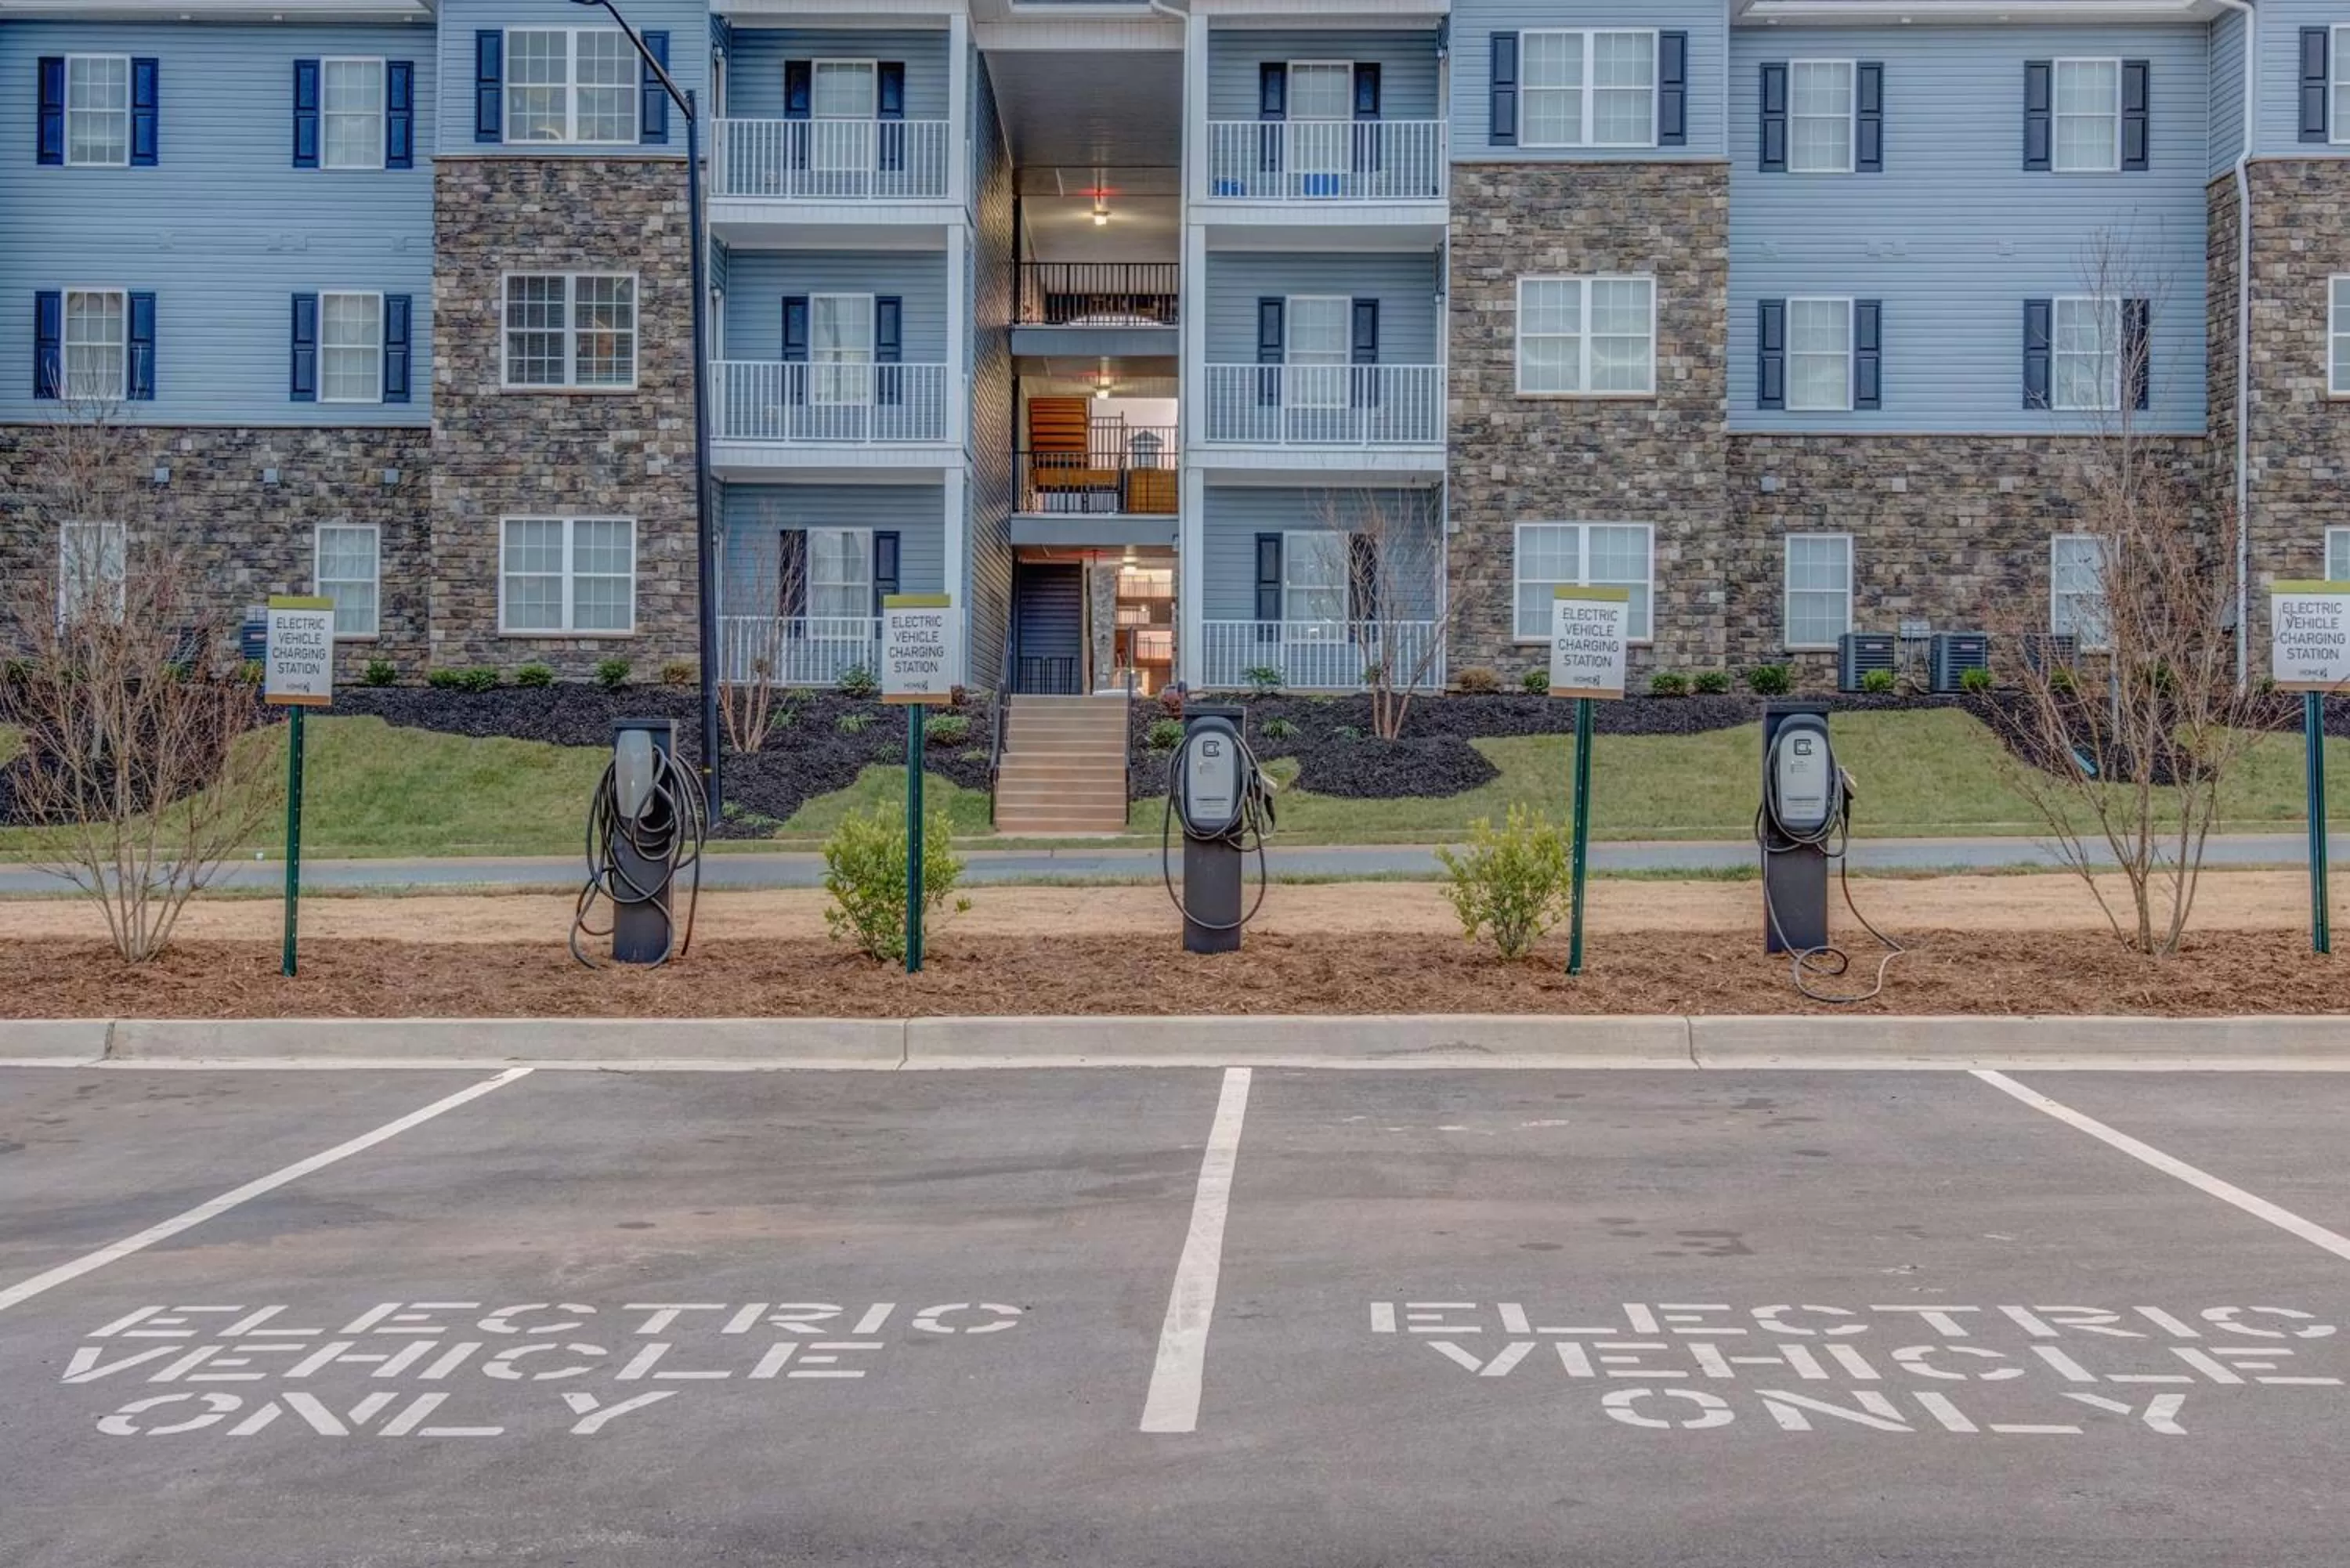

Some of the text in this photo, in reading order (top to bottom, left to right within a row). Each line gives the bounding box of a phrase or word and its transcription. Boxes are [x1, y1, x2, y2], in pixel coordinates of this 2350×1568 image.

[2282, 602, 2343, 614] ELECTRIC
[1562, 608, 1618, 622] ELECTRIC
[276, 616, 325, 630] ELECTRIC
[891, 616, 942, 628] ELECTRIC
[2286, 616, 2340, 629] VEHICLE
[894, 630, 939, 643] VEHICLE
[1564, 623, 1614, 637] VEHICLE
[278, 632, 321, 645] VEHICLE
[1558, 638, 1619, 652] CHARGING
[2280, 632, 2346, 645] CHARGING
[272, 647, 326, 660] CHARGING
[889, 645, 944, 658] CHARGING
[2287, 648, 2340, 659] STATION
[893, 660, 938, 673] STATION
[1563, 654, 1612, 667] STATION
[277, 662, 320, 674] STATION
[85, 1302, 1023, 1338] ELECTRIC
[1370, 1302, 2337, 1339] ELECTRIC
[60, 1340, 884, 1383] VEHICLE
[1426, 1341, 2345, 1385] VEHICLE
[96, 1390, 679, 1436] ONLY
[1600, 1388, 2188, 1435] ONLY
